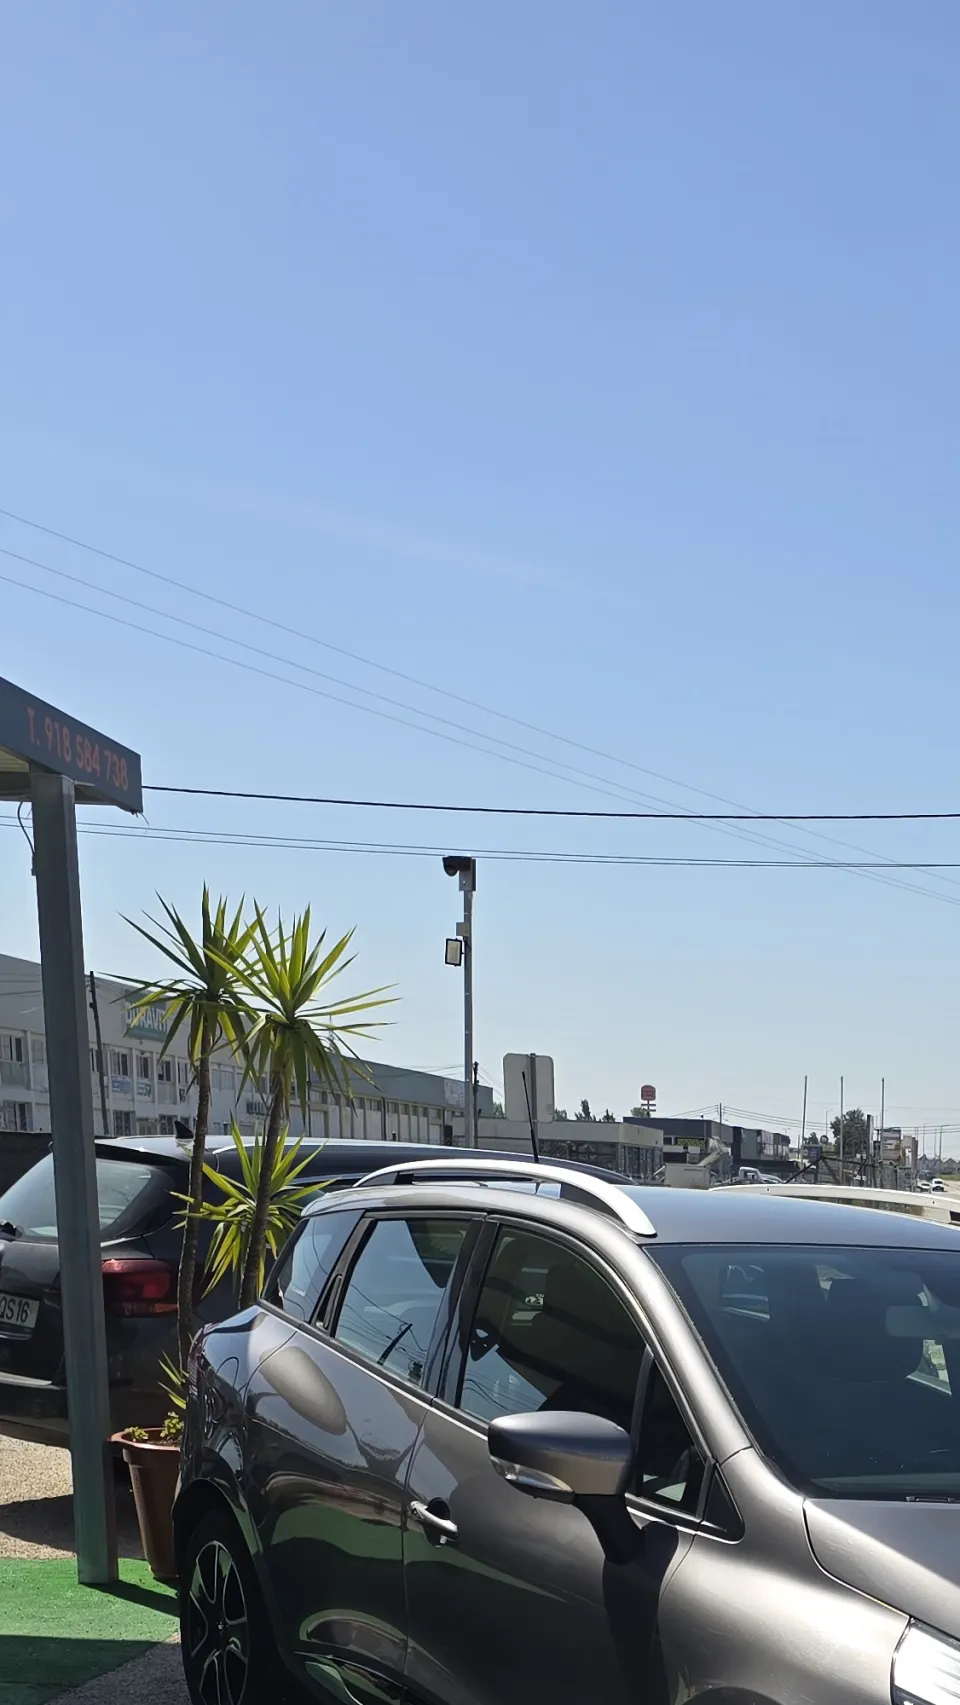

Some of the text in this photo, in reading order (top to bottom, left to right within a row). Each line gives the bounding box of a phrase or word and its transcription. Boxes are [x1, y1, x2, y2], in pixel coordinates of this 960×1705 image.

[45, 717, 72, 762] 918
[76, 734, 101, 776] 584
[104, 749, 128, 791] 738
